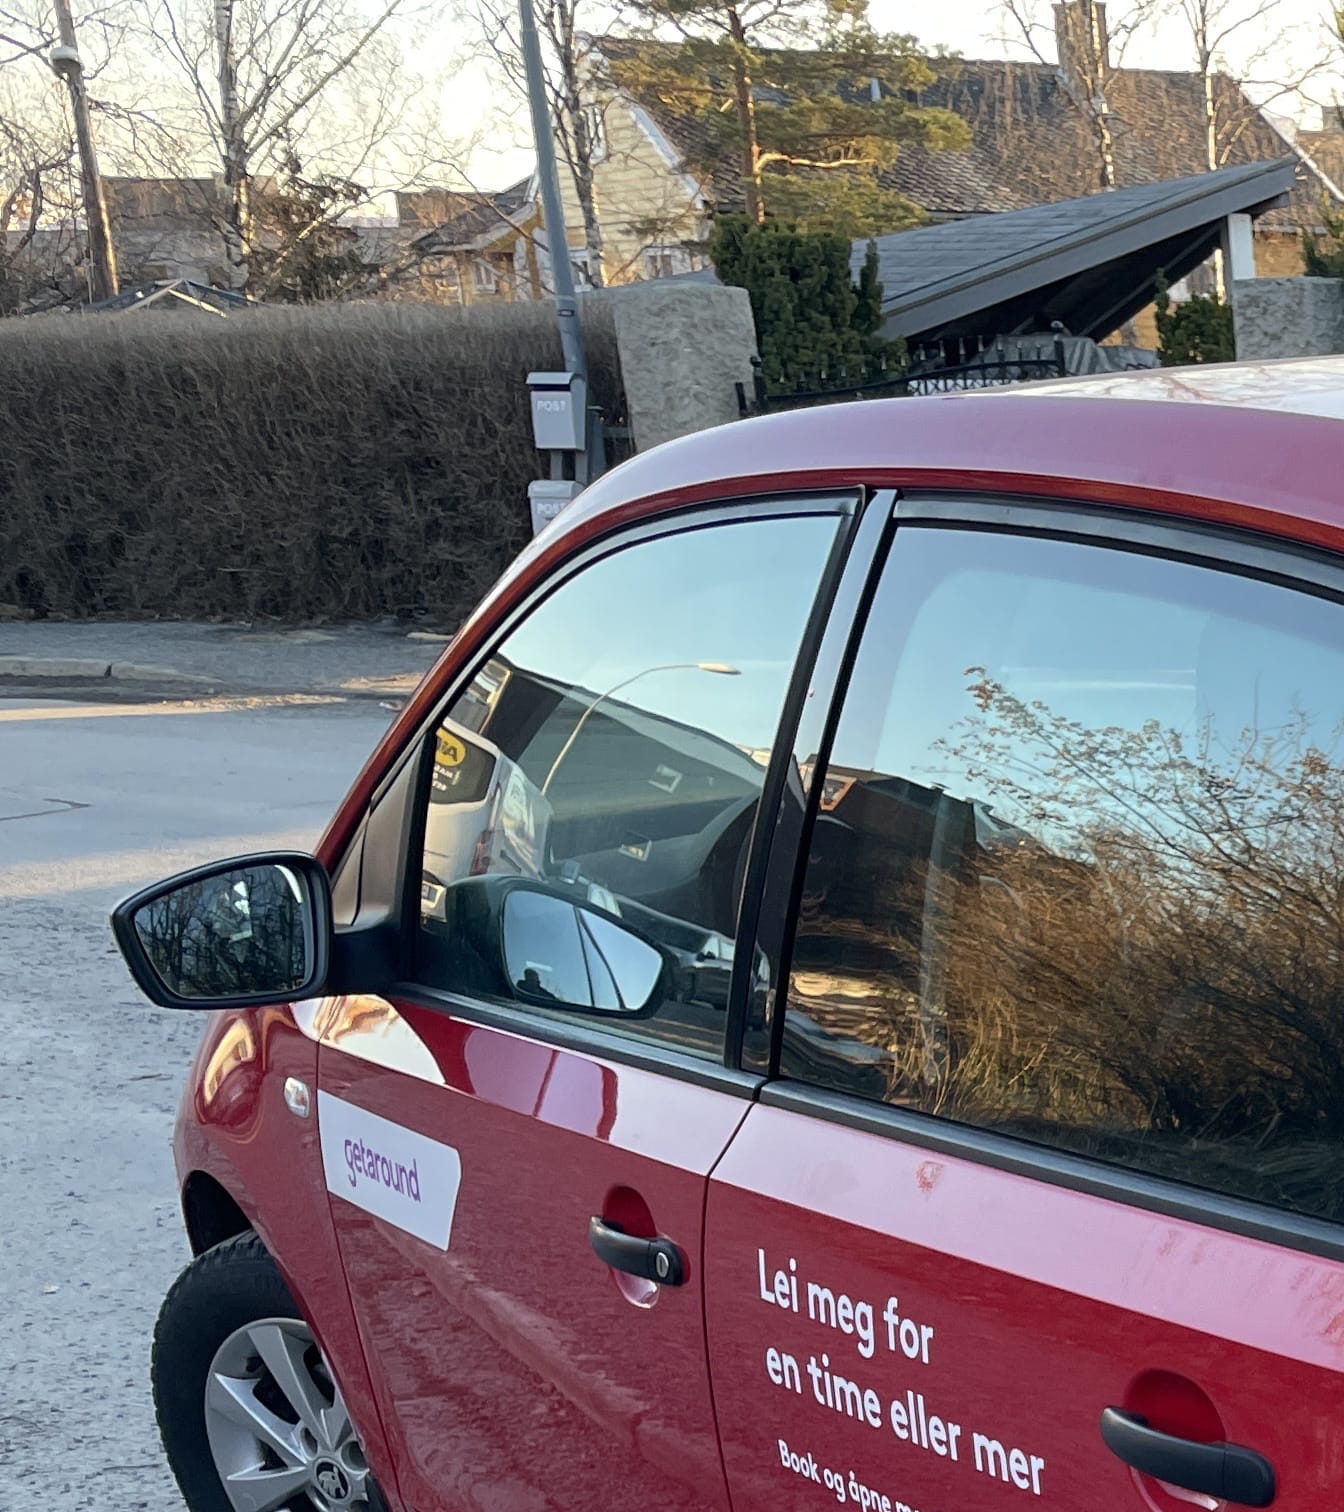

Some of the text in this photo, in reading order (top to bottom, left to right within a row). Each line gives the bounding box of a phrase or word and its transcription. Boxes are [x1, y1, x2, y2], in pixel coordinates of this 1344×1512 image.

[536, 400, 567, 412] POST
[344, 1138, 422, 1203] getaround
[758, 1248, 934, 1364] Lei meg for
[766, 1347, 1045, 1496] en time eller mer
[777, 1439, 821, 1484] Book
[823, 1467, 847, 1503] og
